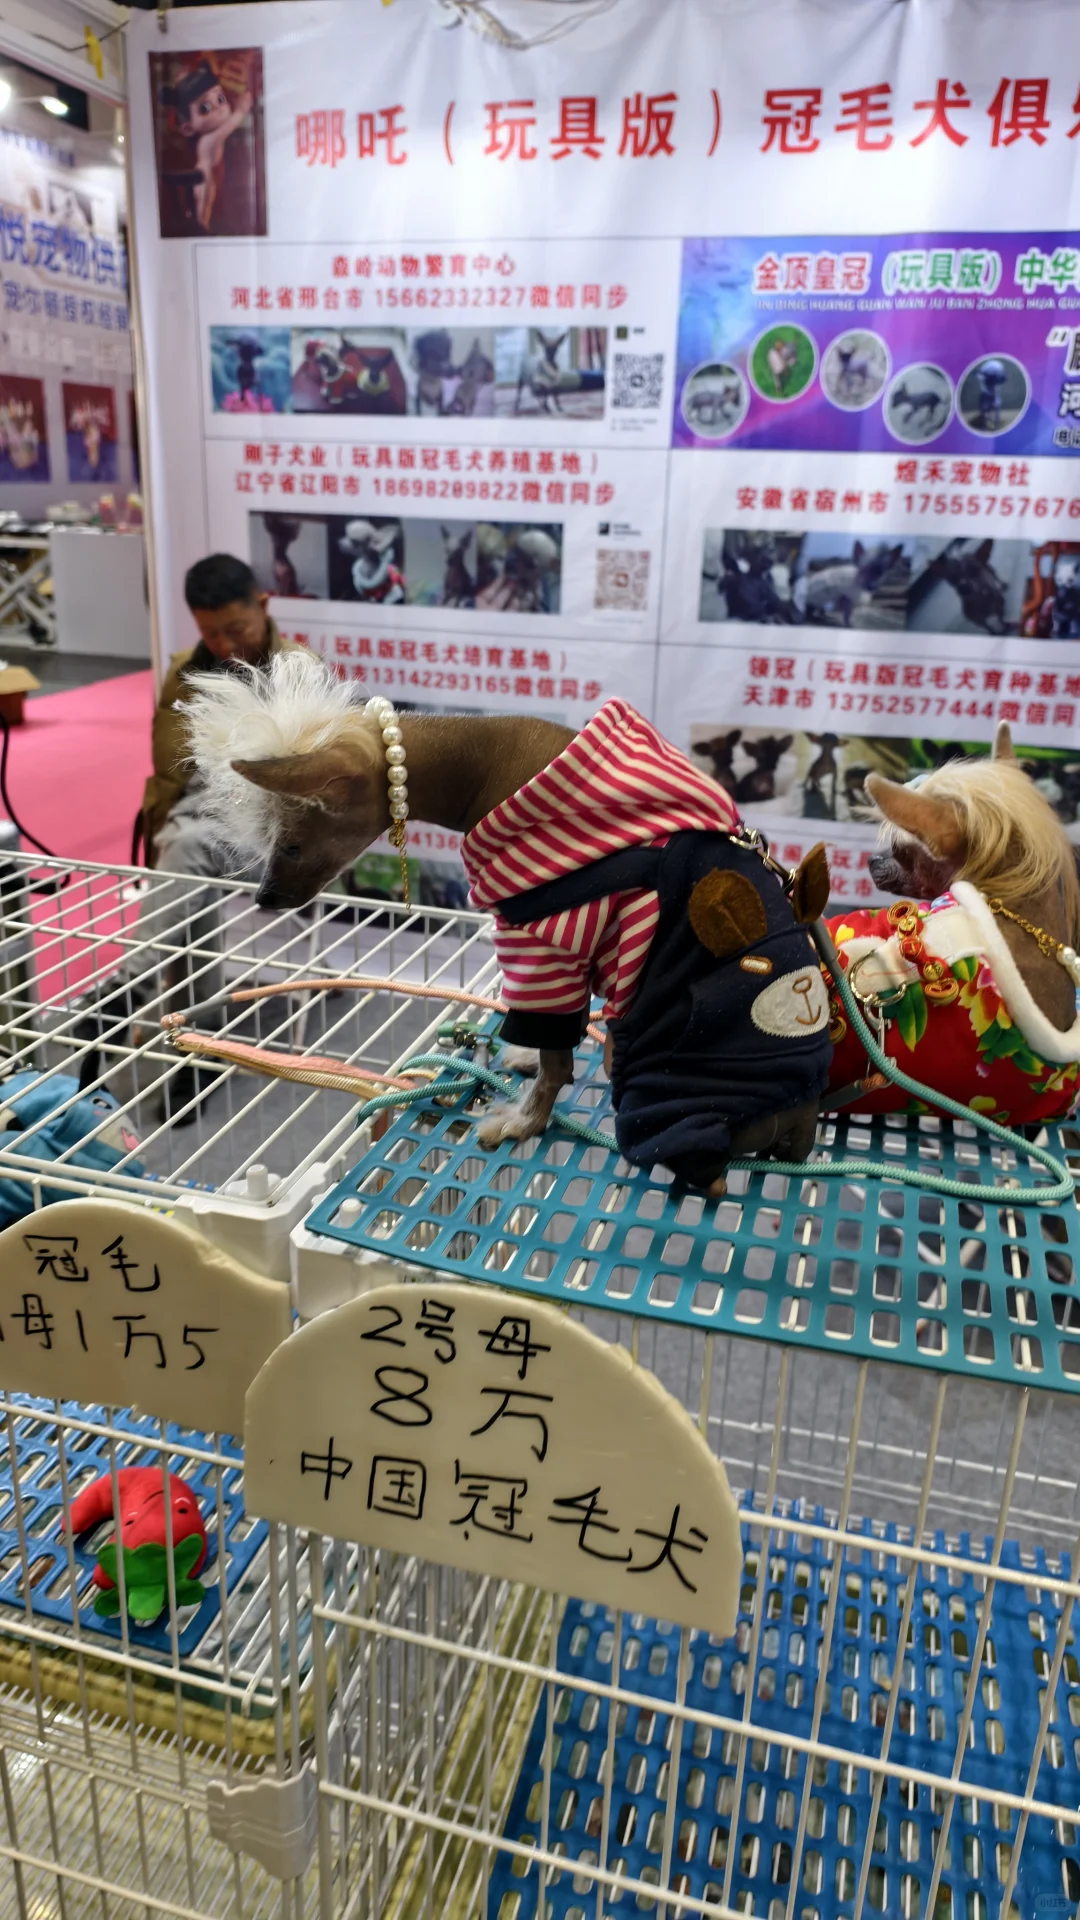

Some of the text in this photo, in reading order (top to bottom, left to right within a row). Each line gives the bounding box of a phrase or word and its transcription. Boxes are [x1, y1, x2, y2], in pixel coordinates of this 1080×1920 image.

[295, 77, 1080, 168] 哪吒（玩具版）冠毛犬俱
[231, 286, 362, 309] 河北省邢台市
[235, 471, 360, 495] 辽宁省辽阳市
[737, 487, 888, 514] 安徽省宿州市
[743, 685, 815, 710] 天津市
[23, 1235, 161, 1292] 冠毛
[300, 1436, 709, 1594] 中国冠毛犬
